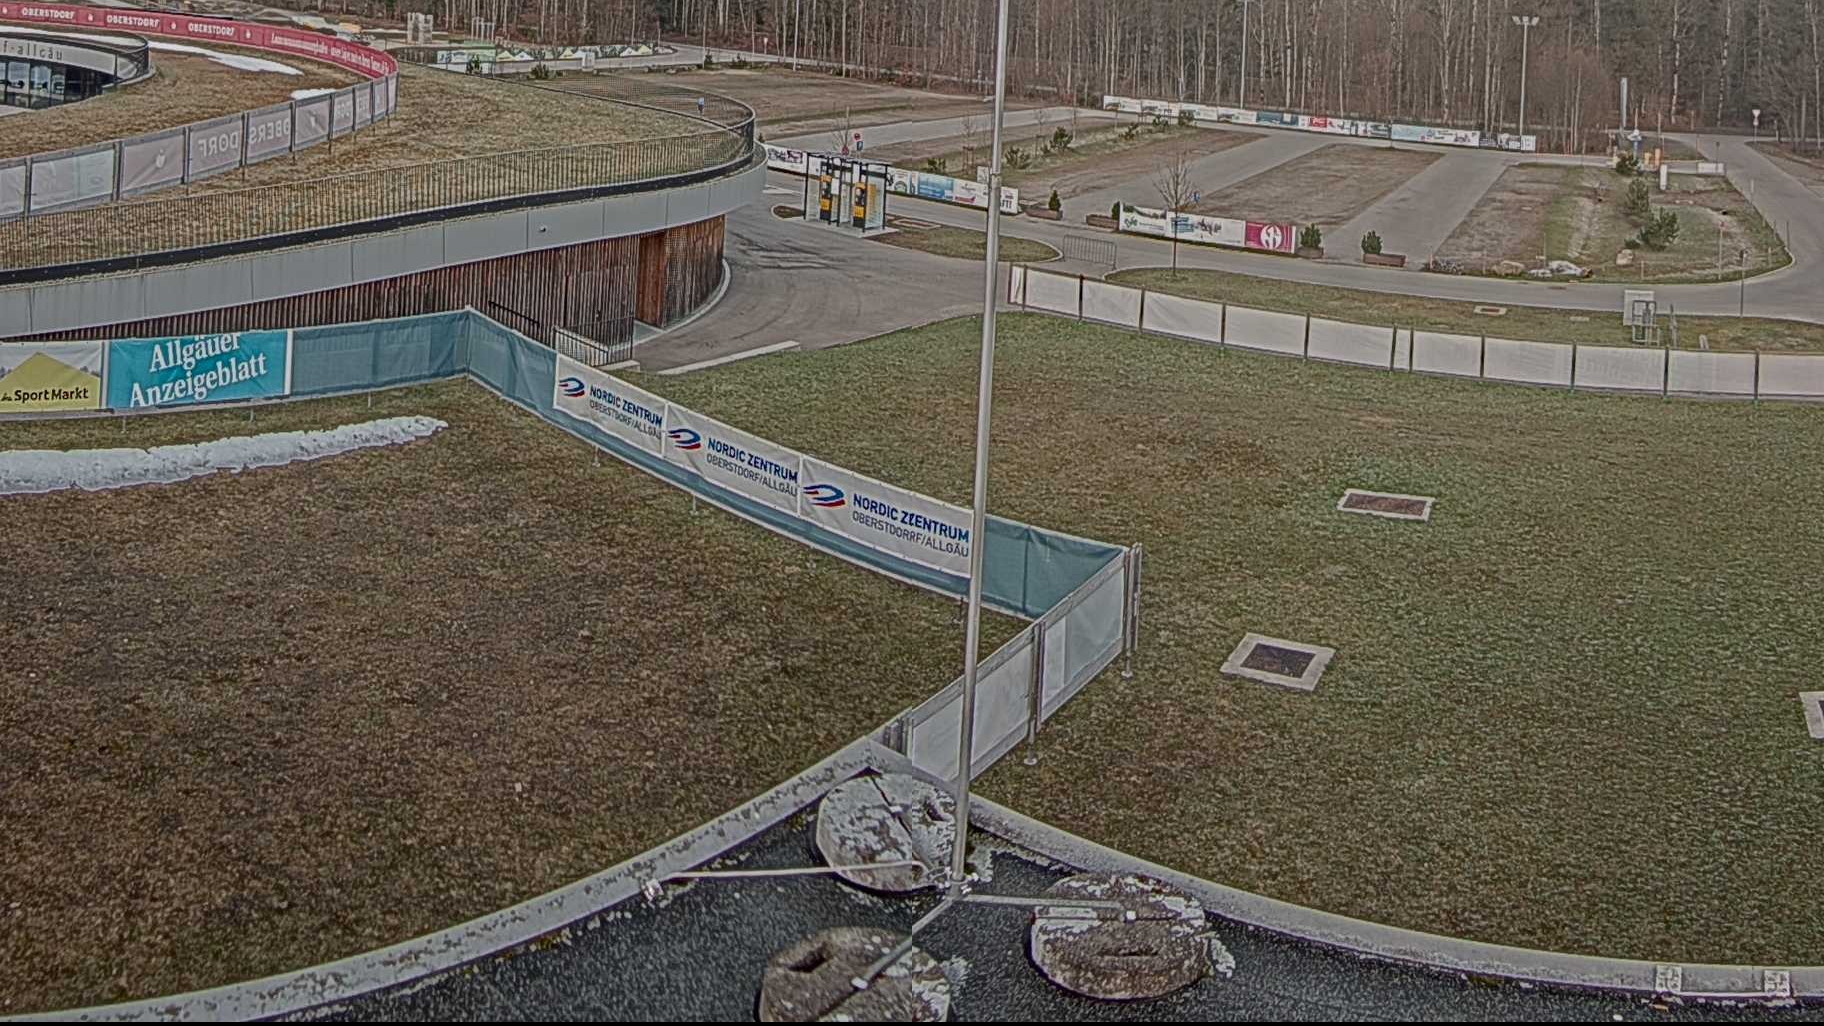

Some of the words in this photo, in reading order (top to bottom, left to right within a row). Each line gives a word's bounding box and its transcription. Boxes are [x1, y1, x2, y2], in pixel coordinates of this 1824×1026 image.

[21, 7, 75, 20] OBERSTDORF
[106, 14, 160, 28] OBERSTDORF
[188, 22, 236, 36] OBERSTDORF
[149, 333, 242, 373] Allgäuer
[129, 352, 268, 409] Anzeigeblatt
[589, 385, 622, 408] NORDIC
[622, 400, 663, 426] ZENTRUM
[706, 453, 798, 498] OBERSTDORF/ALLGÄU
[707, 437, 747, 463] NORDIC
[747, 454, 799, 484] ZENTRUM
[853, 493, 898, 522] NORDIC
